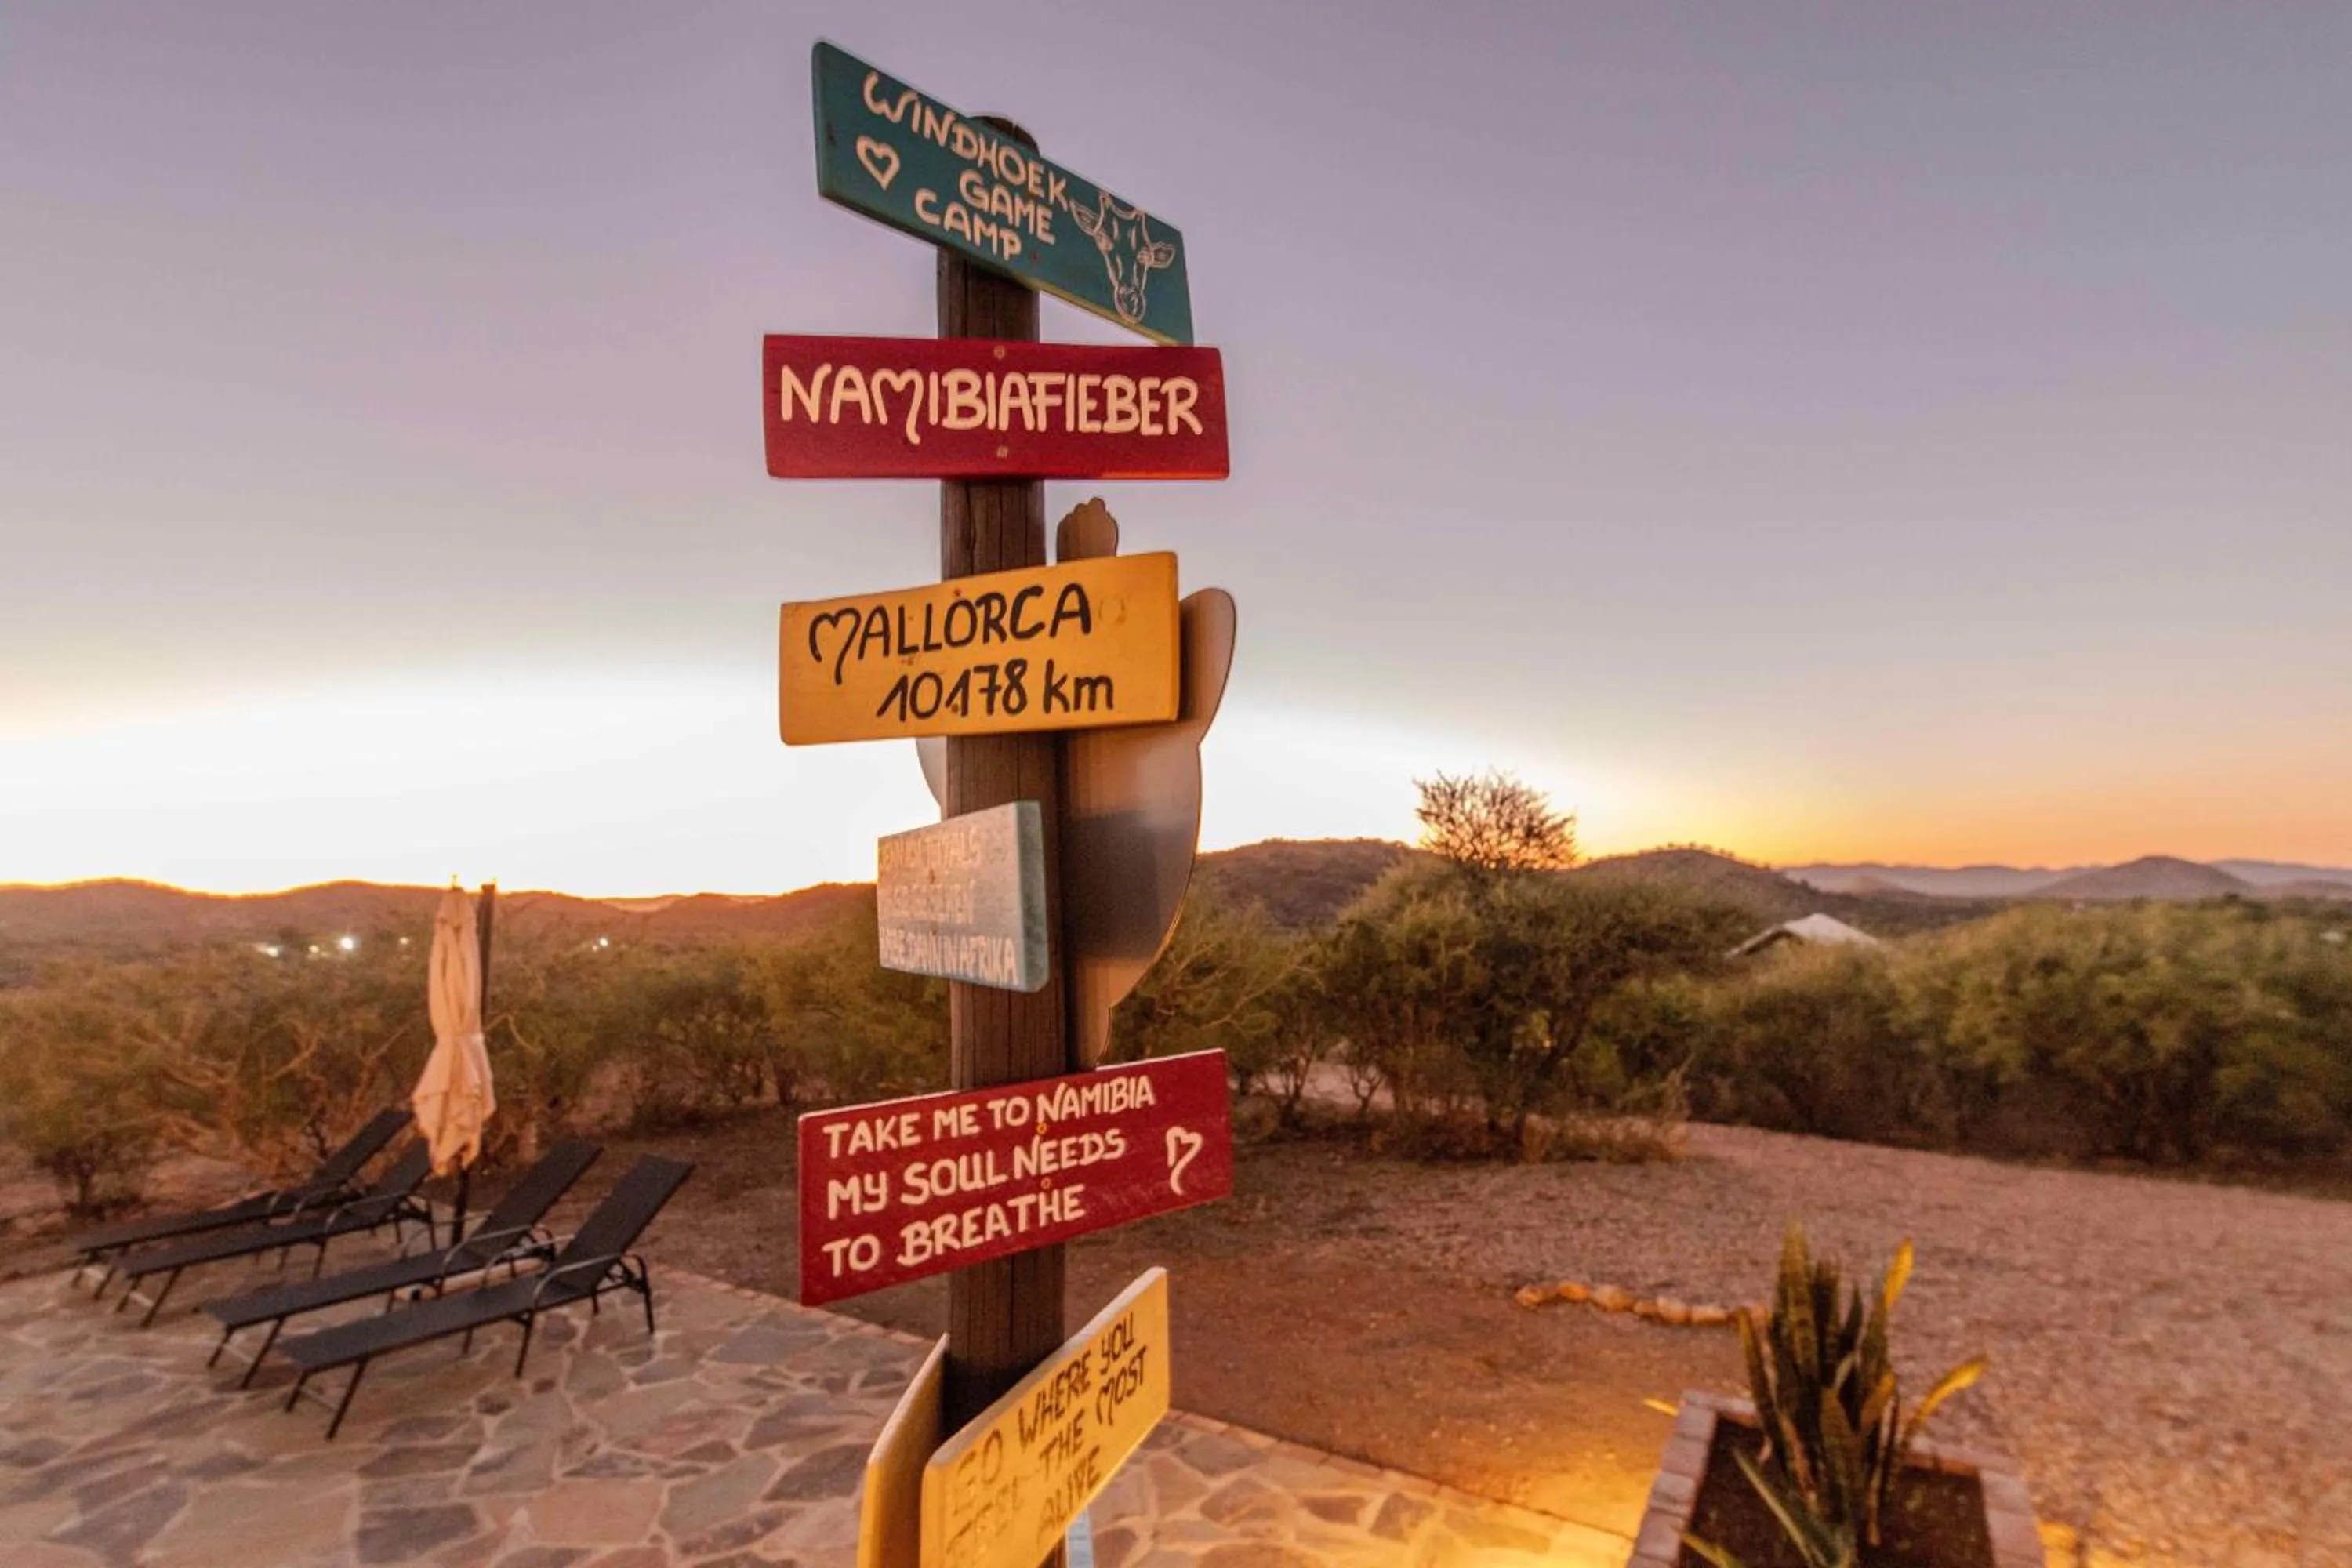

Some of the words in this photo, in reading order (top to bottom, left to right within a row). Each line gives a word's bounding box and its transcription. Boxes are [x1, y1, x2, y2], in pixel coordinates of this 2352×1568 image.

[862, 71, 1071, 212] WINDHOEK
[914, 187, 1022, 261] CAMP
[958, 169, 1057, 245] GAME
[782, 363, 1203, 445] NAMIBIAFIEBER
[808, 583, 1092, 686] MALLORCA
[875, 659, 1029, 723] 10178
[1043, 659, 1114, 714] km
[822, 1112, 921, 1159] TAKE
[933, 1104, 980, 1140] ME
[988, 1096, 1030, 1128] TO
[1037, 1075, 1156, 1123] NAMIBIA
[827, 1171, 887, 1221] MY
[900, 1151, 1008, 1206] SOUL
[1013, 1127, 1127, 1180] NEEDS
[822, 1234, 880, 1278] TO
[896, 1184, 1087, 1267] BREATHE
[1018, 1349, 1091, 1451] WHERE
[1099, 1312, 1134, 1377] YOU
[1039, 1409, 1084, 1481] THE
[1095, 1345, 1148, 1427] MOST
